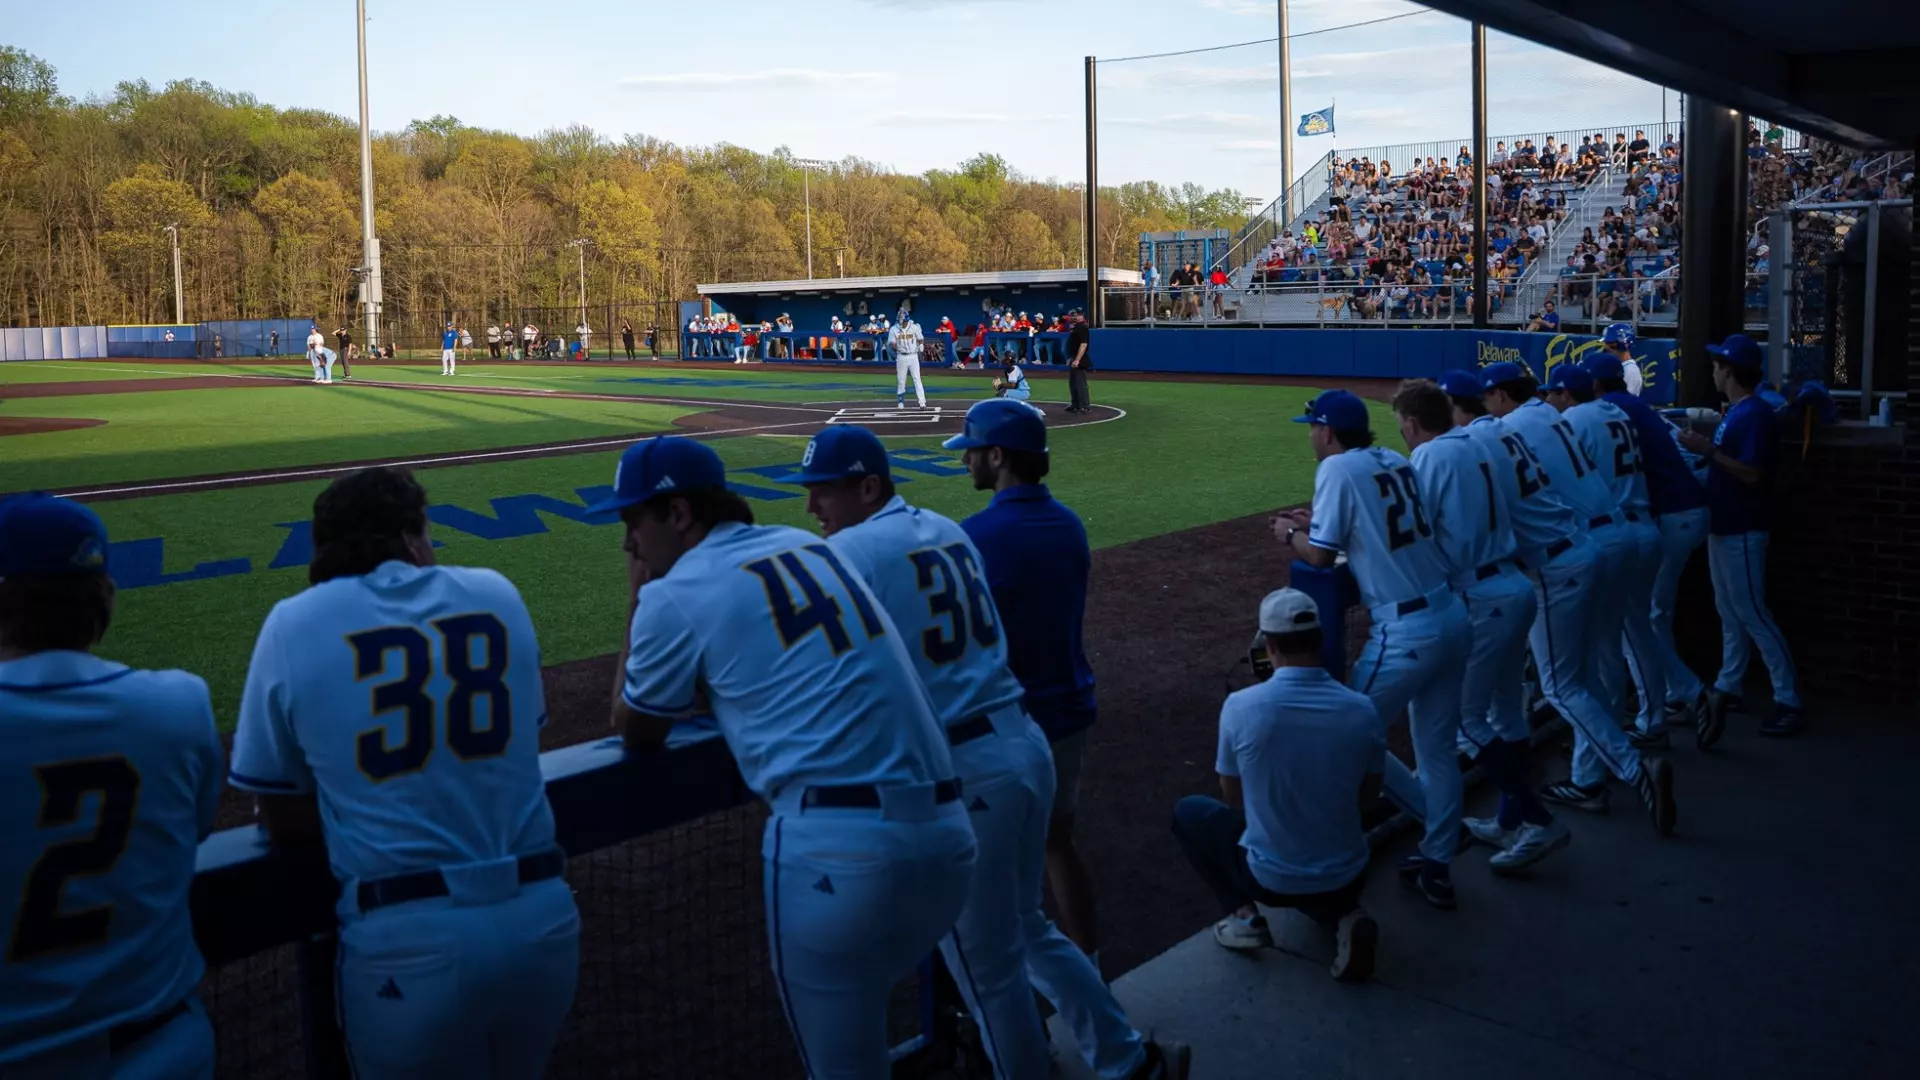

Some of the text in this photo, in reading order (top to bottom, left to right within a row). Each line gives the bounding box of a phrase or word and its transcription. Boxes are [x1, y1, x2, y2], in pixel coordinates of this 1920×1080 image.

[1477, 340, 1520, 363] Delaware
[1372, 465, 1432, 551] 28
[1479, 461, 1497, 533] 1
[742, 543, 885, 657] 41
[345, 613, 513, 782] 38
[7, 755, 140, 962] 2
